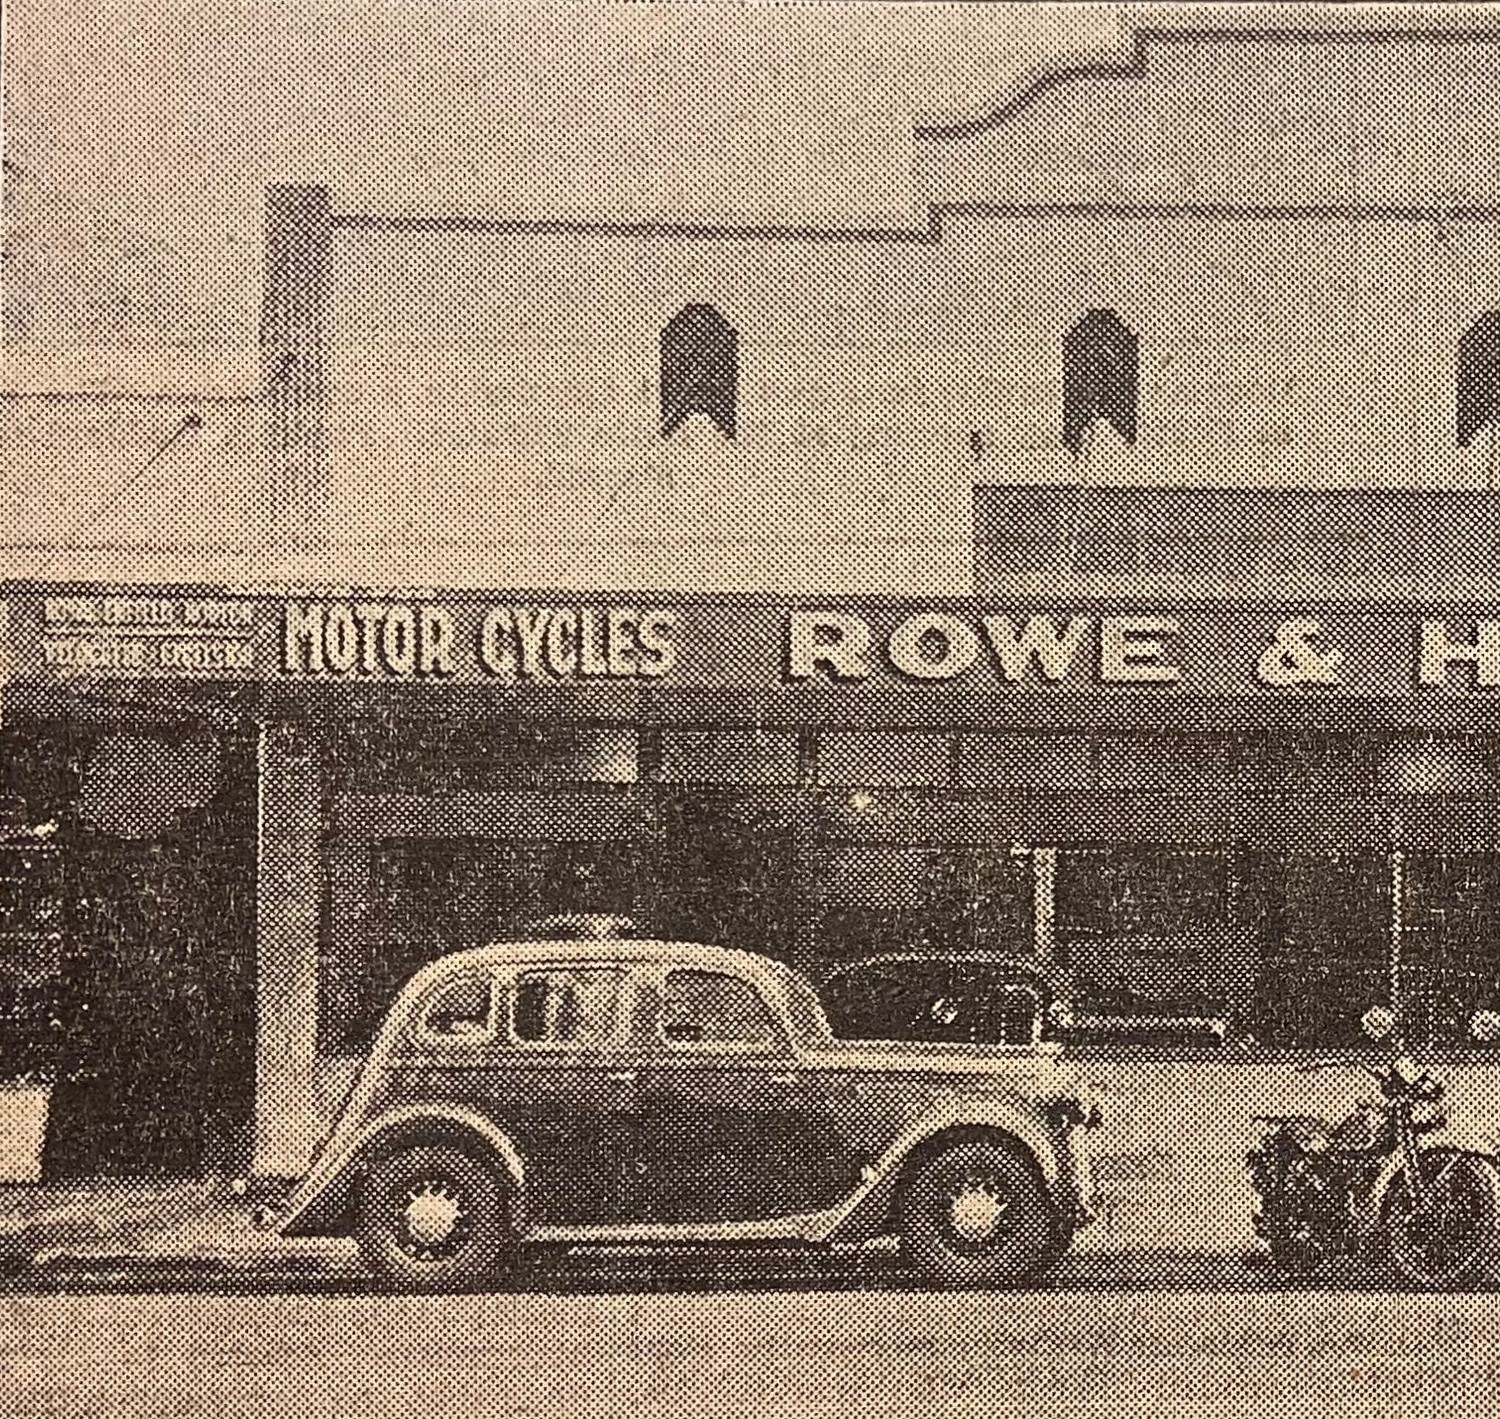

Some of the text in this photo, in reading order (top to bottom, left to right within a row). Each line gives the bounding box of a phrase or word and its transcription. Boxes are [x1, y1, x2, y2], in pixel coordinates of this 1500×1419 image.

[283, 603, 679, 680] MOTOR CYCLES
[788, 610, 1182, 686] ROWE
[1257, 616, 1344, 688] &
